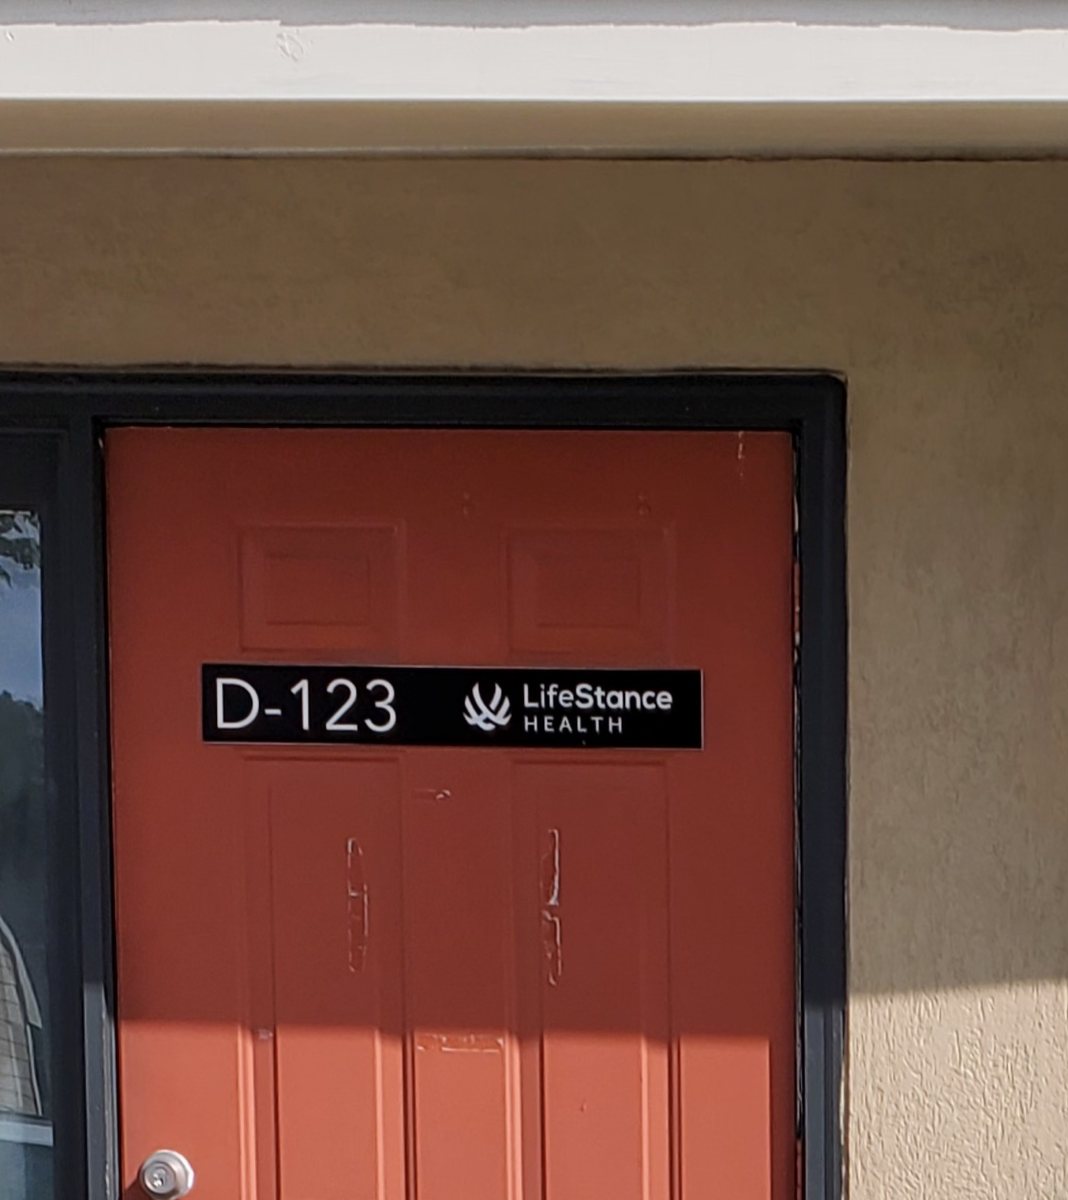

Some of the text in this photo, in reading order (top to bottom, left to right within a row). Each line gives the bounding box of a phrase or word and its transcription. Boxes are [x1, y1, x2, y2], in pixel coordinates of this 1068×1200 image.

[215, 677, 398, 733] D-123
[522, 682, 674, 711] LifeStance
[523, 714, 624, 733] HEALTH
